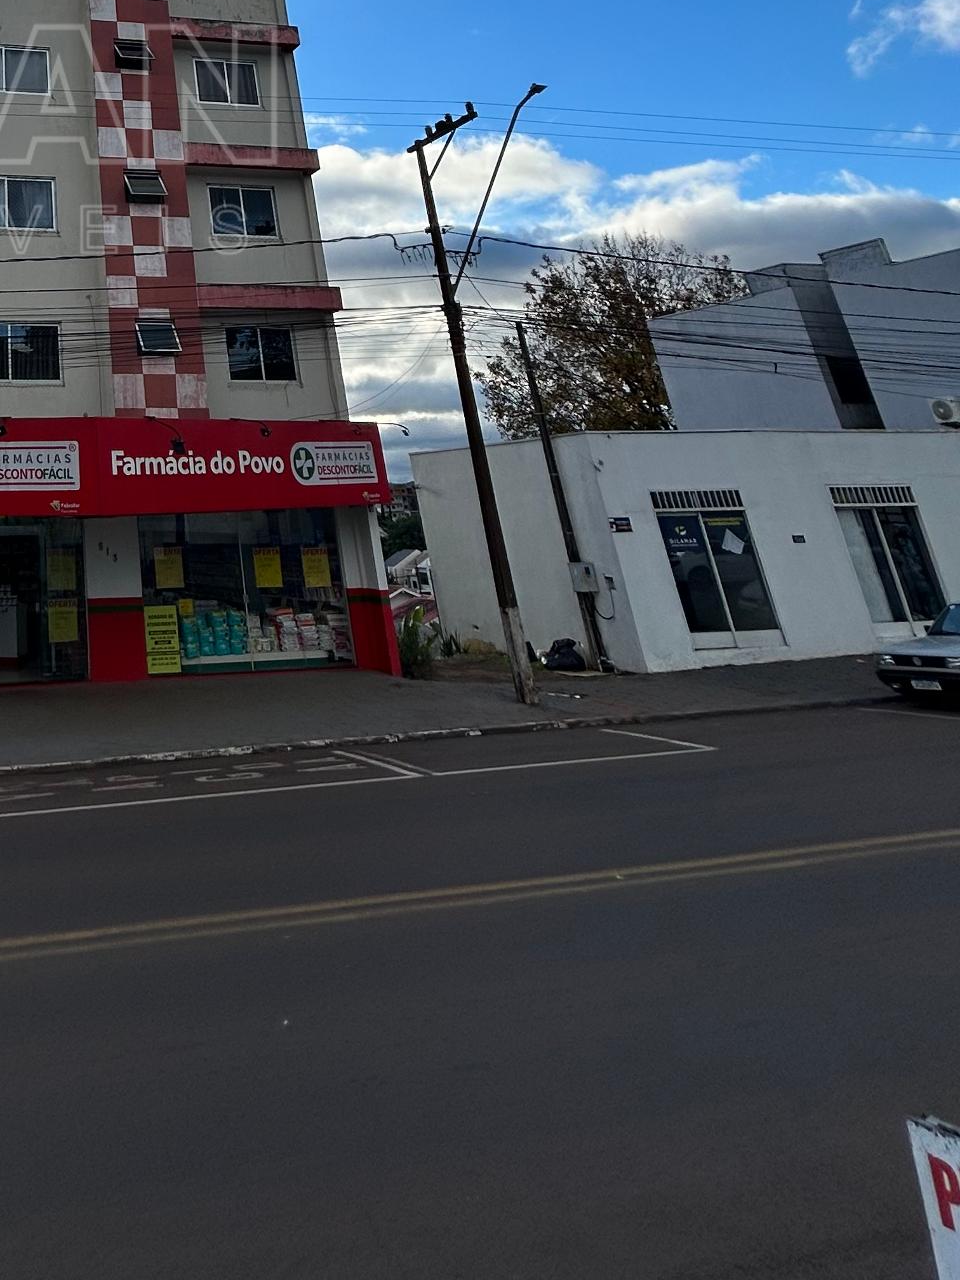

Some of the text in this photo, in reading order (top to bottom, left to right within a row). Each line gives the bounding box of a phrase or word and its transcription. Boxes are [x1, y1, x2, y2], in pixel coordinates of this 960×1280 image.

[111, 450, 285, 475] Farmácia do Povo
[315, 452, 370, 462] FARMÁCIAS
[318, 463, 373, 476] DESCONTOFÁCIL
[927, 1152, 960, 1232] P
